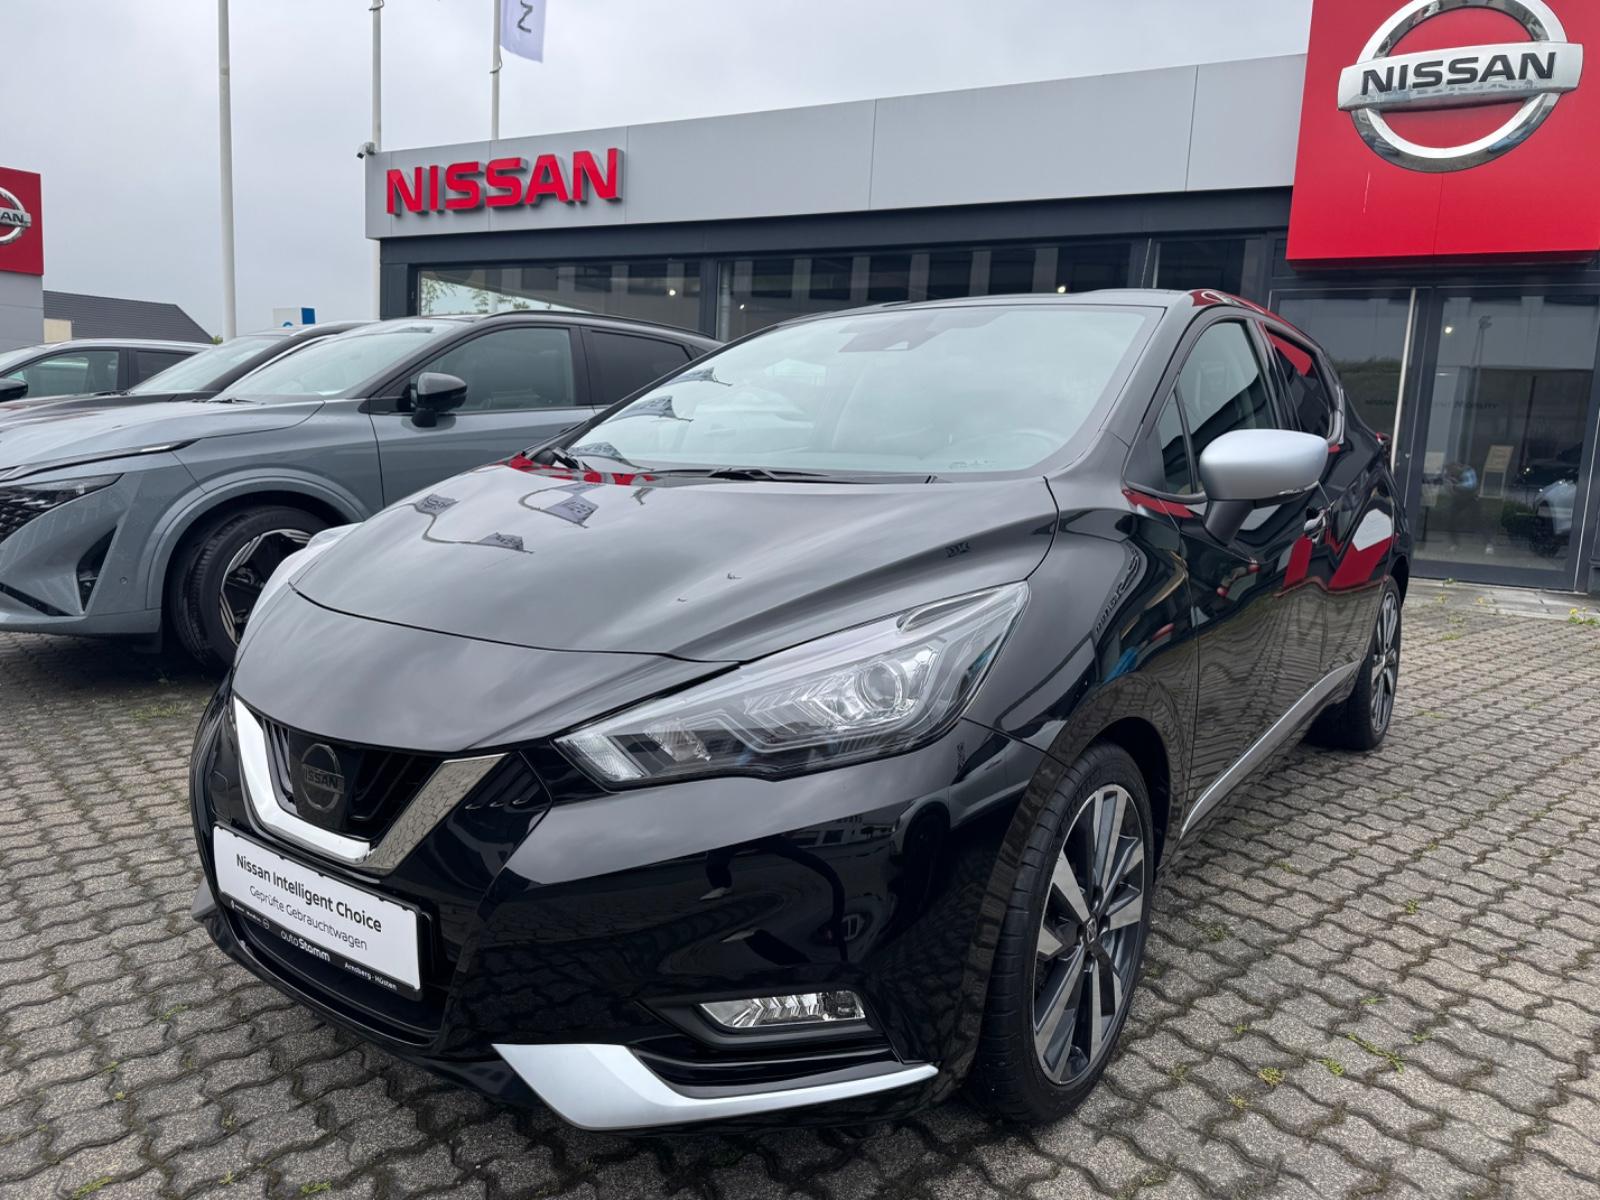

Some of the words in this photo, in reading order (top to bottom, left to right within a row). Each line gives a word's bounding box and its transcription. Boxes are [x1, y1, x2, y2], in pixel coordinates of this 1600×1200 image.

[1361, 52, 1556, 96] NISSAN
[387, 147, 619, 215] NISSAN
[236, 853, 271, 882] Nissan
[273, 871, 334, 912] Intelligent
[336, 902, 382, 932] Choice
[249, 885, 285, 913] Geprüfte
[286, 905, 367, 951] Gebrauchtwagen
